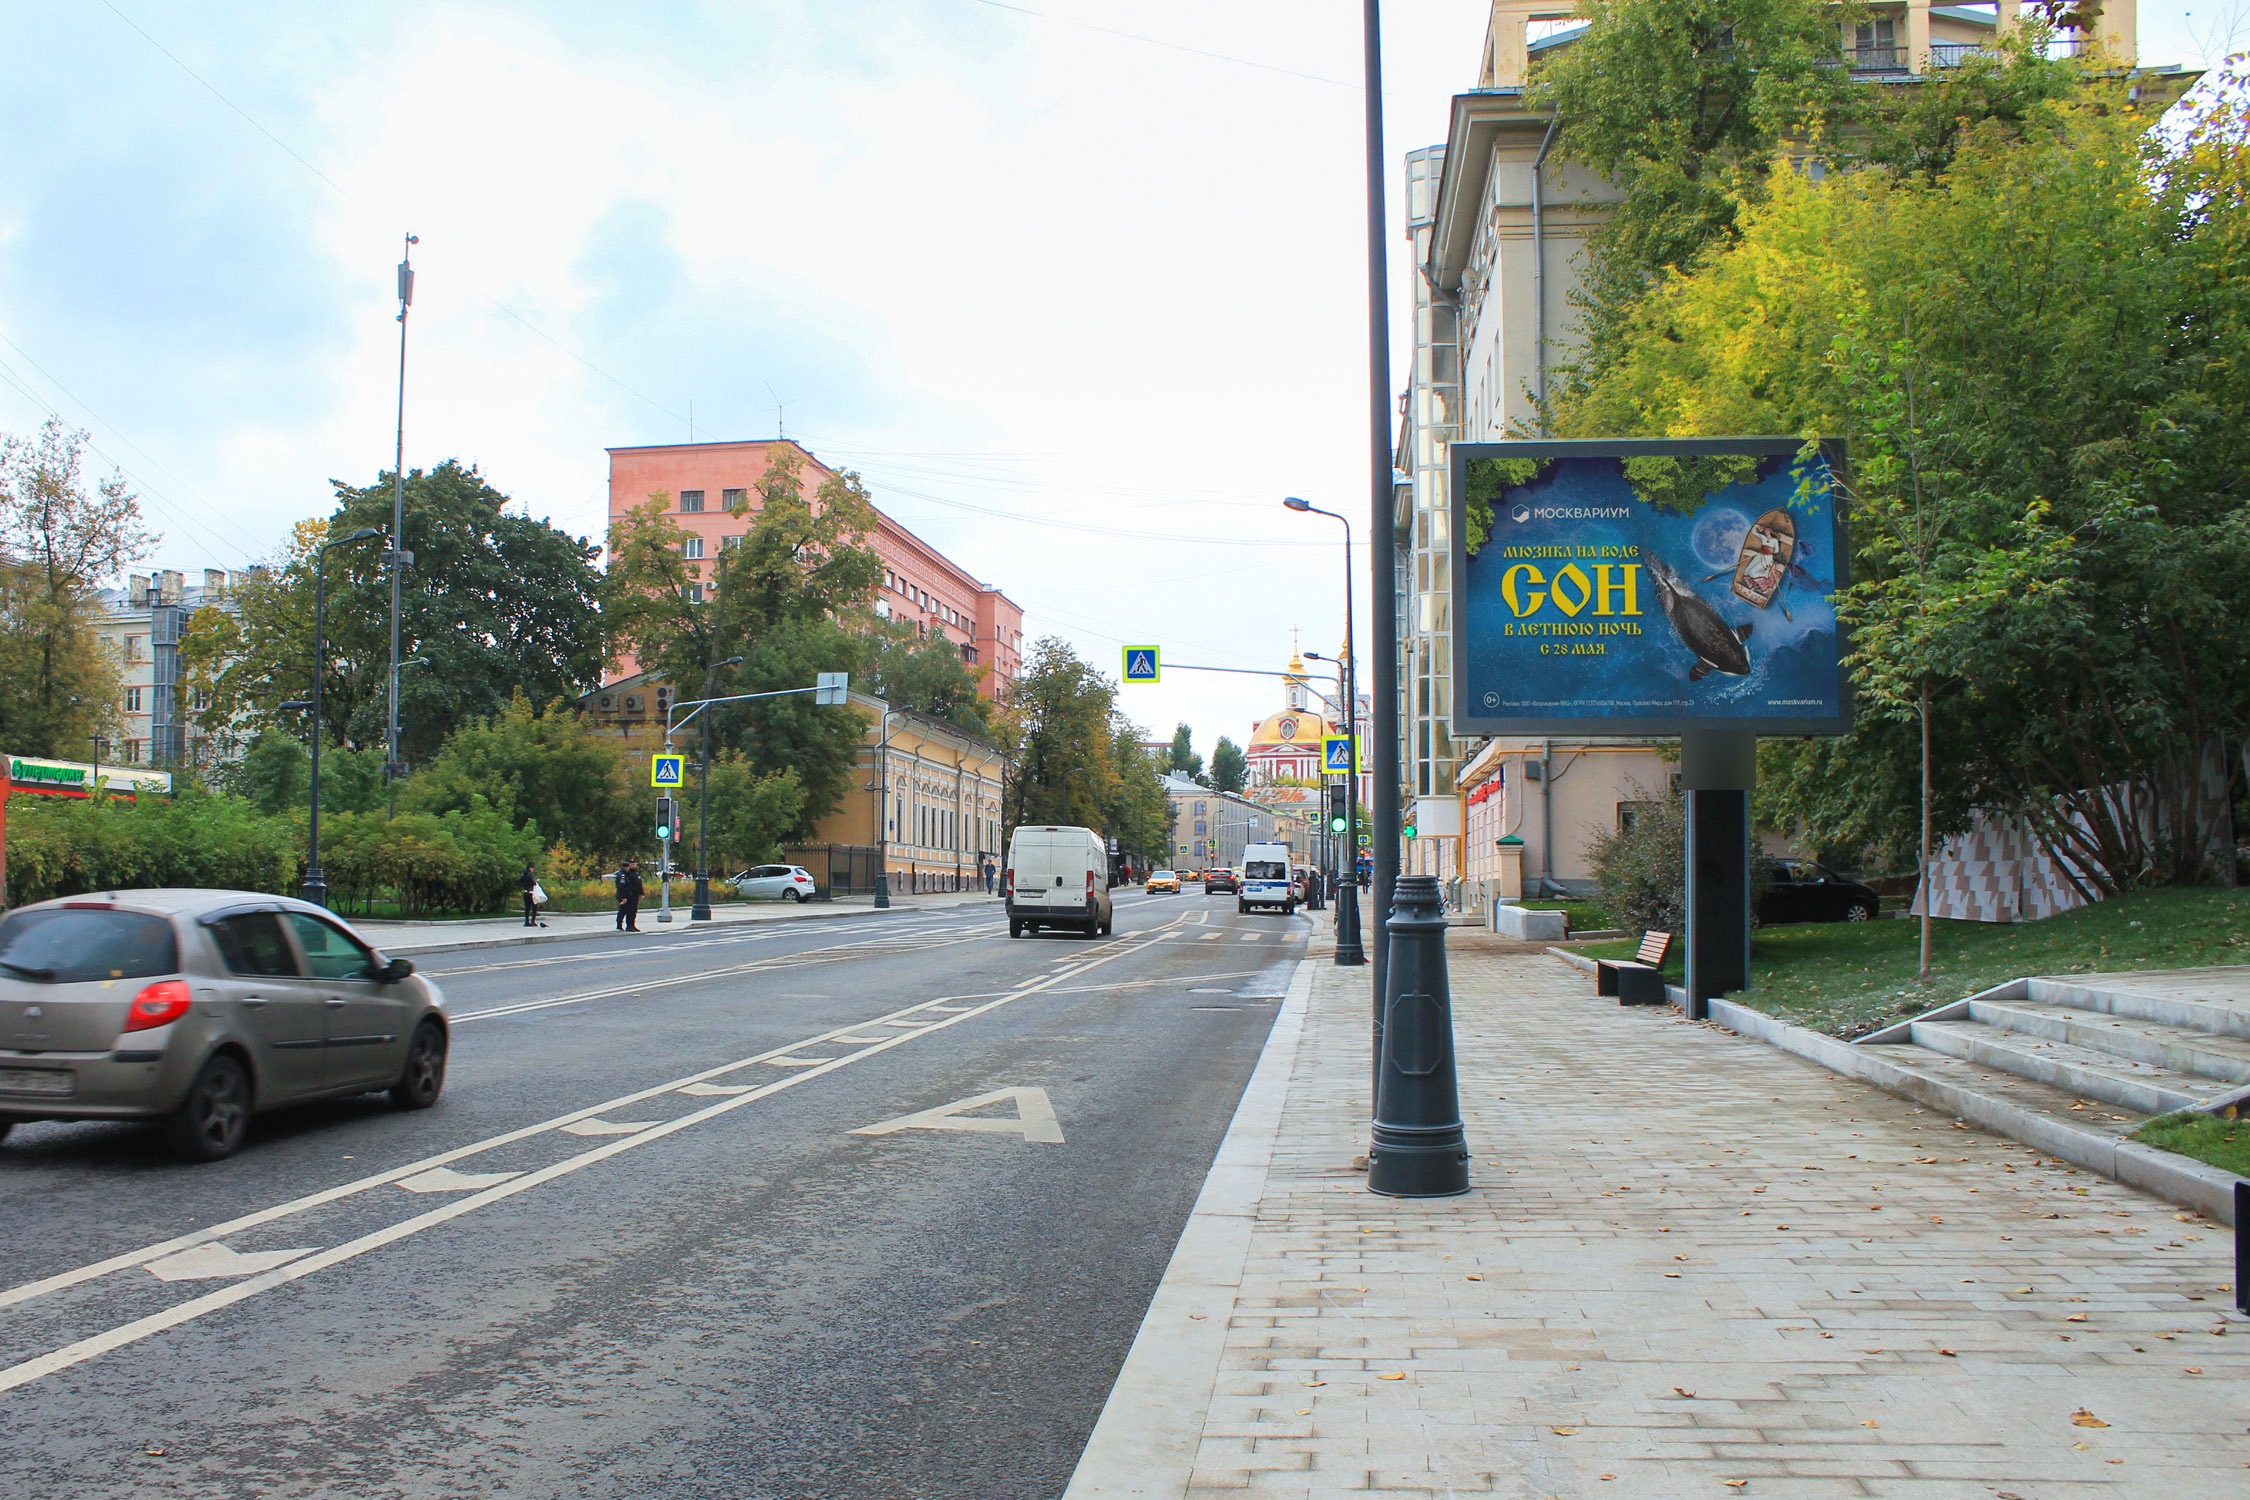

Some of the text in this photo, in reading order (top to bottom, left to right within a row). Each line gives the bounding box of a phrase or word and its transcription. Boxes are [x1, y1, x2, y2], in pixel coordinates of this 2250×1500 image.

[1534, 507, 1630, 519] МОСКВАРИУМ
[1503, 545, 1640, 559] МЮЗИКЛ НА ВОДЕ
[1501, 562, 1643, 618] СОН
[1504, 622, 1642, 636] В ЛЕТНЮЮ НОЧЬ
[1540, 643, 1606, 655] С 28 МАЯ
[1486, 695, 1497, 704] 0+
[12, 759, 87, 784] Супермаркет
